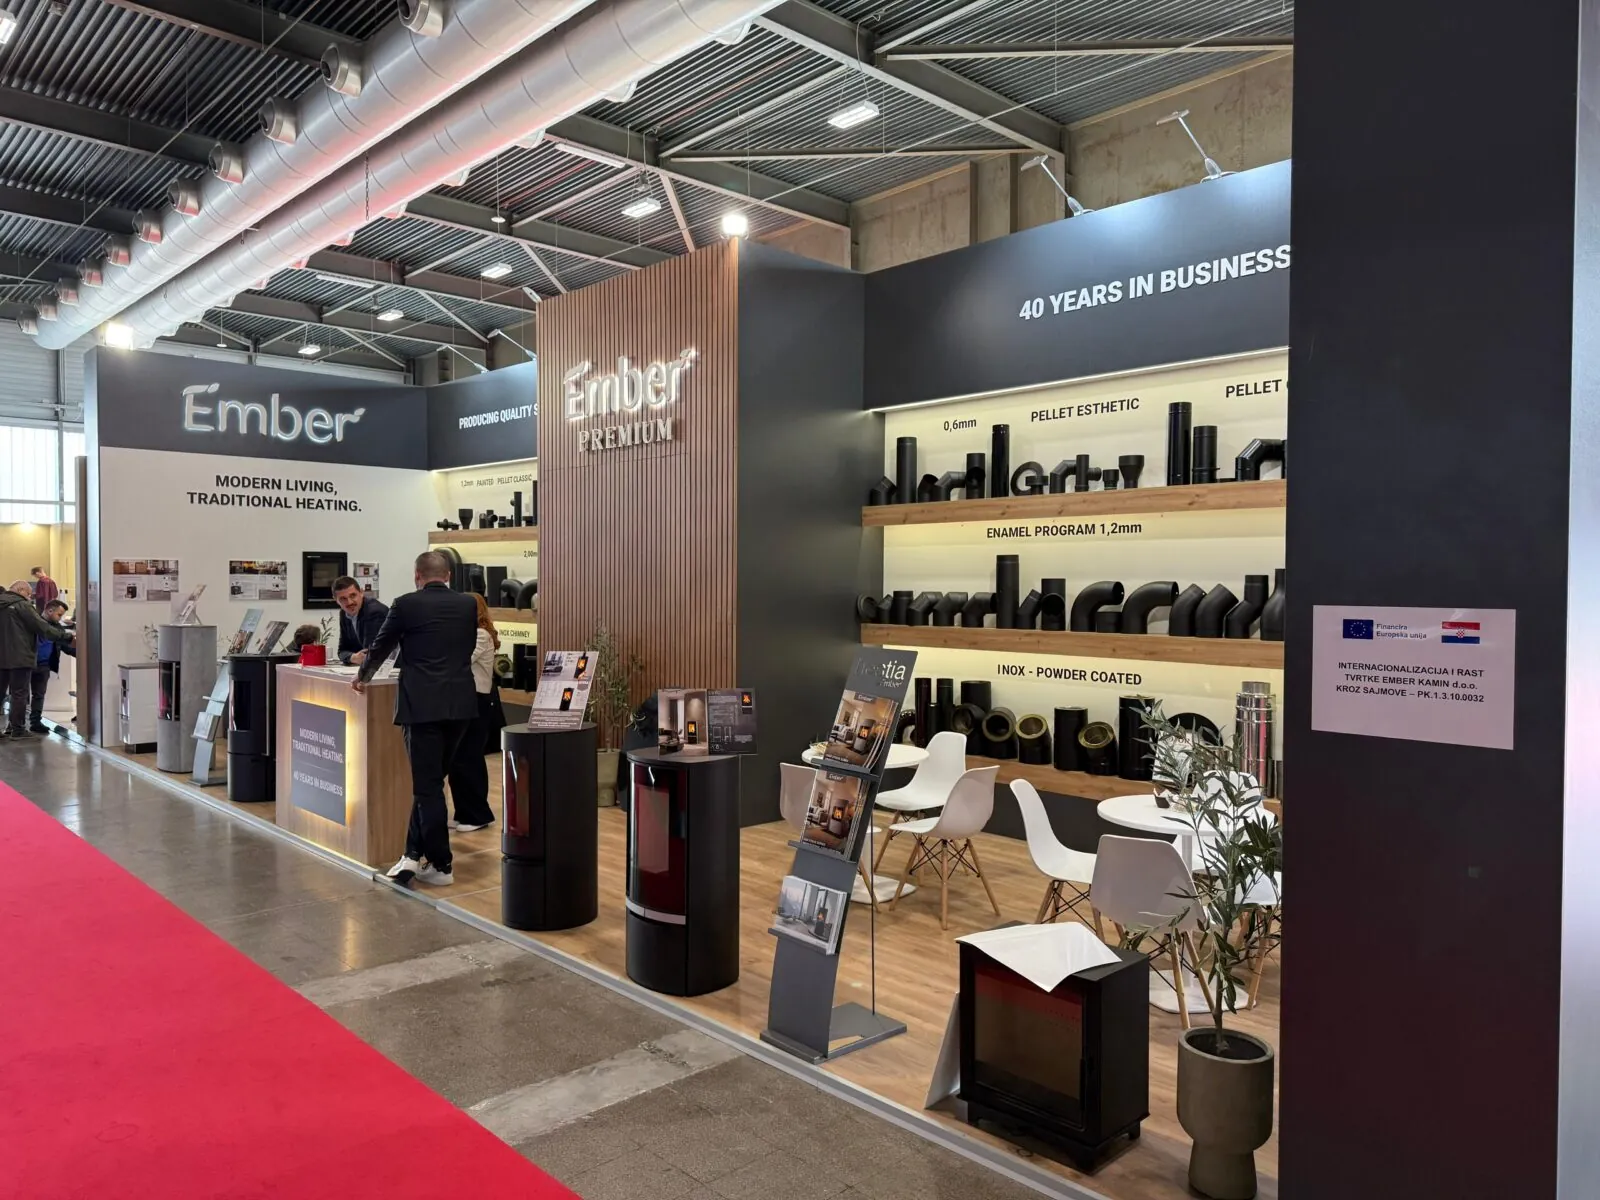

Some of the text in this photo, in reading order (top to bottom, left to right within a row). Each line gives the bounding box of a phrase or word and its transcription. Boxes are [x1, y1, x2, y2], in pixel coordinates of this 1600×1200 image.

[1019, 245, 1291, 320] 40 YEARS IN BUSINESS
[563, 347, 698, 421] Ember
[1226, 379, 1282, 398] PELLET
[182, 383, 366, 443] Ember
[459, 411, 499, 429] PRODUCING
[500, 404, 532, 423] QUALITY
[1031, 398, 1140, 422] PELLET ESTHETIC
[579, 417, 673, 452] PREMIUM
[943, 418, 977, 432] 0,6mm
[215, 475, 338, 496] MODERN LIVING,
[477, 478, 494, 487] PAINTED
[497, 474, 532, 485] PELLET CLASSIC
[187, 492, 362, 512] TRADITIONAL HEATING.
[987, 523, 1142, 538] ENAMEL PROGRAM 1,2mm
[510, 630, 530, 638] CHIMNEY
[1036, 667, 1087, 681] POWDER
[1090, 671, 1142, 685] COATED
[1338, 662, 1449, 675] INTERNACIONALIZACIJA
[1457, 668, 1484, 677] RAST
[1345, 673, 1478, 690] TVRTKE EMBER KAMIN d.o.o.
[1336, 685, 1361, 693] KROZ
[1363, 686, 1407, 697] SAJMOVE
[1417, 690, 1484, 702] PK.1.3.10.0032
[293, 739, 321, 757] TRADITIONAL
[300, 728, 336, 749] MODERN LIVING,
[300, 772, 314, 786] YEARS
[314, 777, 320, 788] IN
[320, 780, 343, 797] BUSINESS
